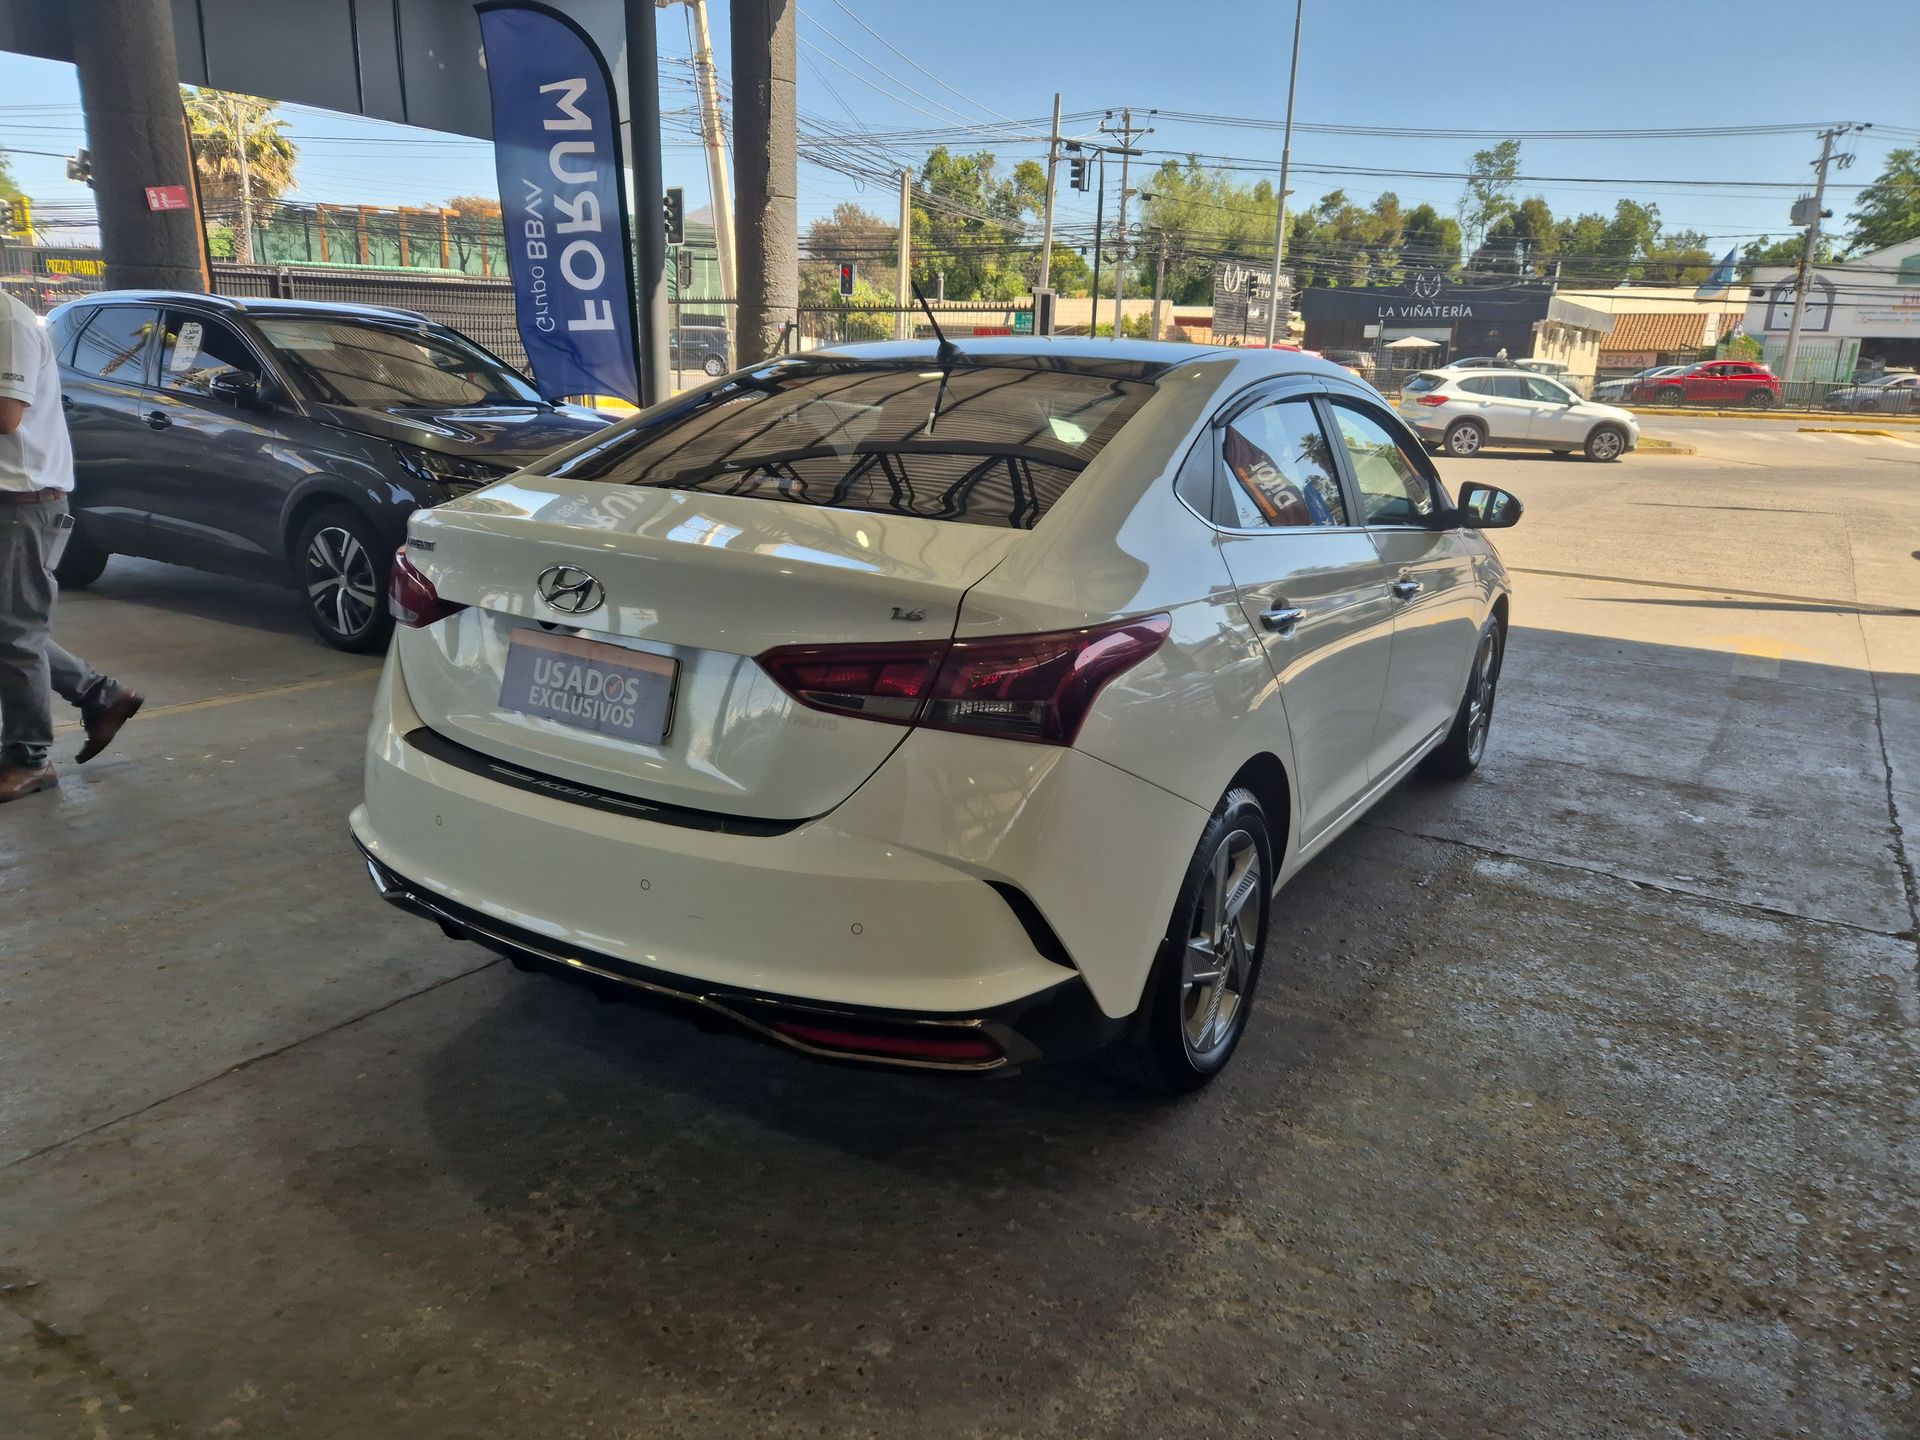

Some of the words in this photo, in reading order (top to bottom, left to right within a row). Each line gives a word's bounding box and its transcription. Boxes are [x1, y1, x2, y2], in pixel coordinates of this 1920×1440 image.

[1378, 306, 1395, 318] LA
[1400, 303, 1473, 318] VIÑATERÍA
[533, 657, 640, 706] USADOS
[528, 685, 636, 729] EXCLUSIVOS
[532, 780, 600, 799] ACCENT
